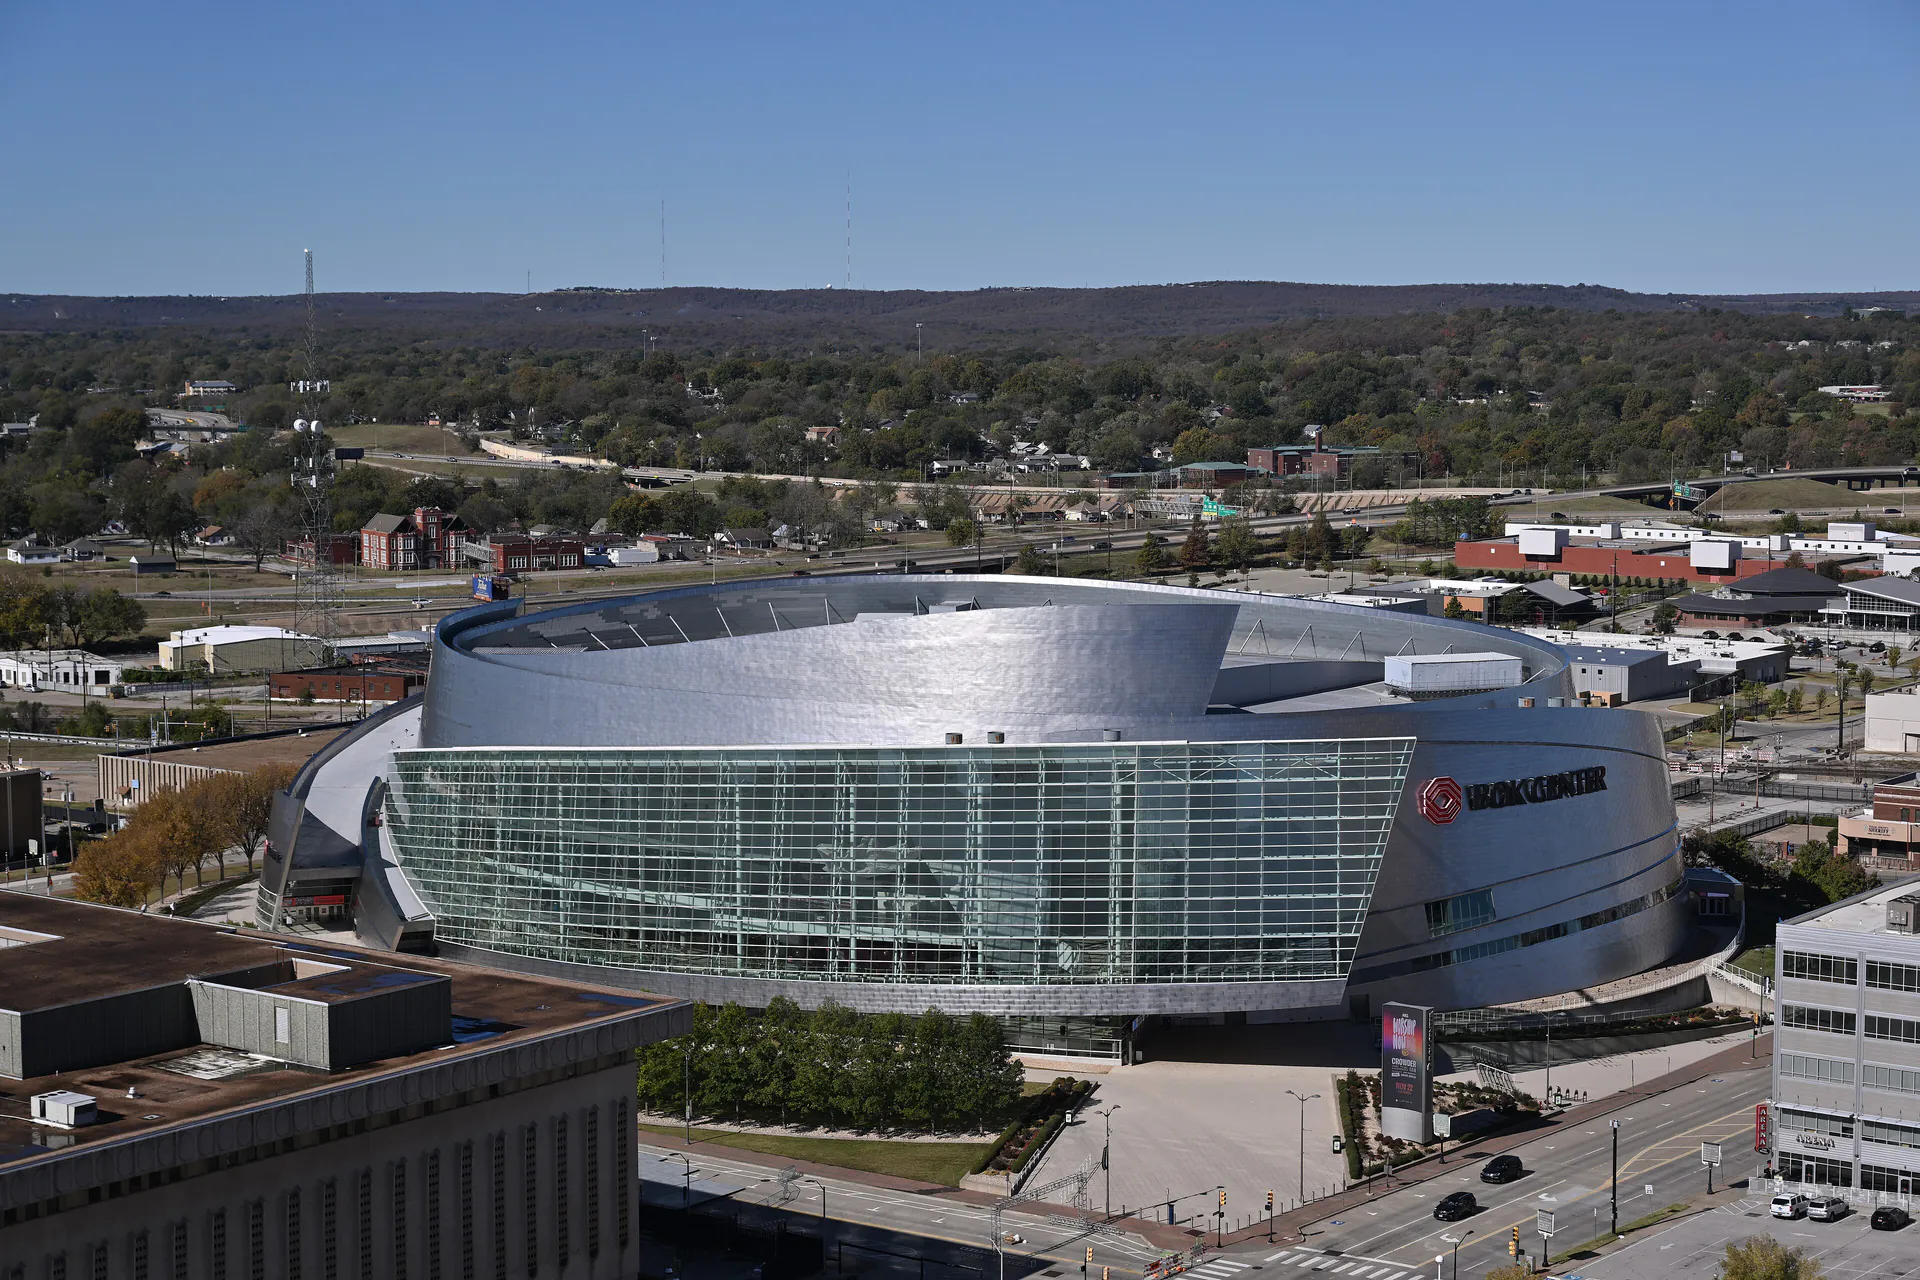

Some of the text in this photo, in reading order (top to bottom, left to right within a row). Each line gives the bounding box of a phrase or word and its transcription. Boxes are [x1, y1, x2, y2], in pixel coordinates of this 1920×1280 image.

[1466, 766, 1608, 811] BOK CENTER
[1392, 1018, 1416, 1036] WORSHIP
[1392, 1034, 1406, 1050] NOW
[1392, 1058, 1416, 1068] CROWDER
[1407, 1084, 1414, 1092] 22
[1796, 1133, 1836, 1148] ARENA
